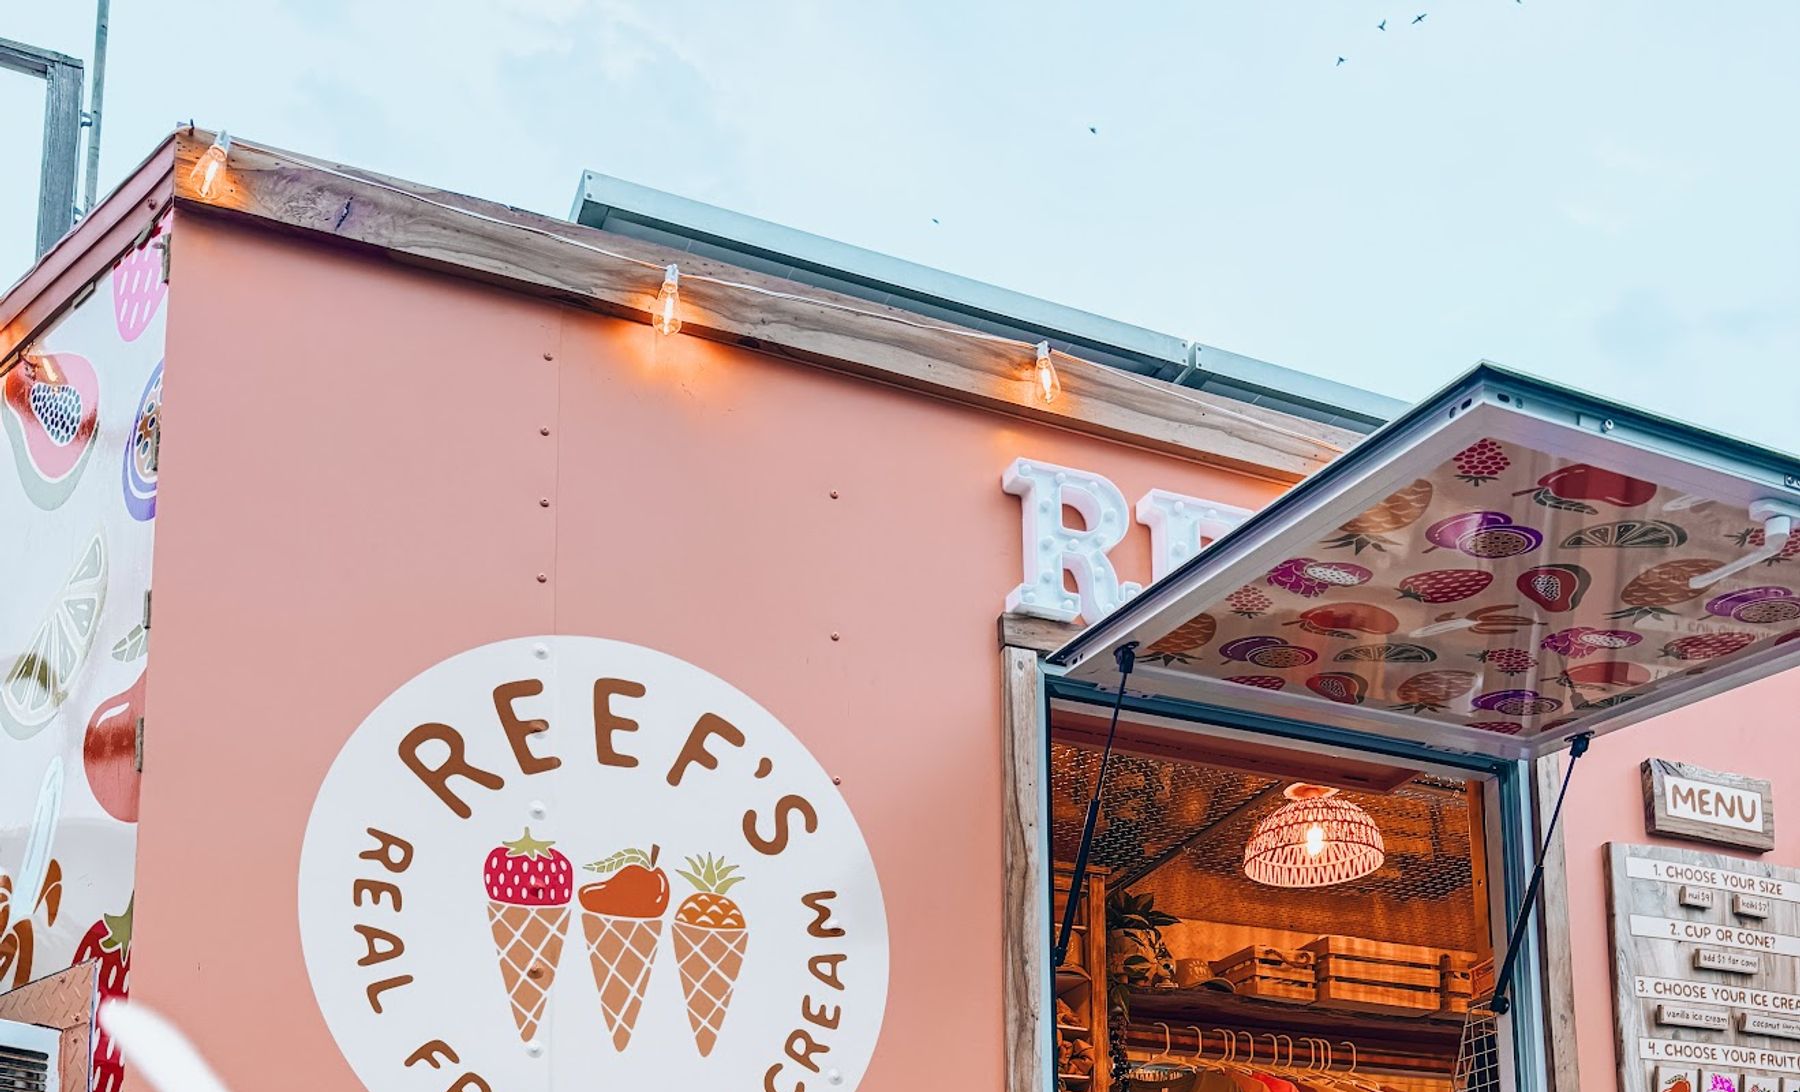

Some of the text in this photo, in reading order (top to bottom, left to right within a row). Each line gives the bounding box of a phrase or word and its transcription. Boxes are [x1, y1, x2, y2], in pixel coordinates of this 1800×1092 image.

[398, 677, 818, 856] REEF'S
[1672, 784, 1757, 823] MENU
[1653, 864, 1783, 895] 1. CHOOSE YOUR SIZE
[352, 827, 414, 1014] REAL
[1670, 923, 1776, 949] 2. CUP OR CONE?
[1638, 980, 1648, 993] 3.
[1653, 982, 1706, 999] CHOOSE
[1711, 987, 1746, 1004] YOUR
[1750, 993, 1768, 1007] ICE
[1666, 1010, 1728, 1024] vanilla ice cream
[1752, 1020, 1780, 1030] coconut
[1648, 1041, 1659, 1055] 4.
[1664, 1043, 1718, 1060] CHOOSE
[1723, 1048, 1756, 1064] YOUR
